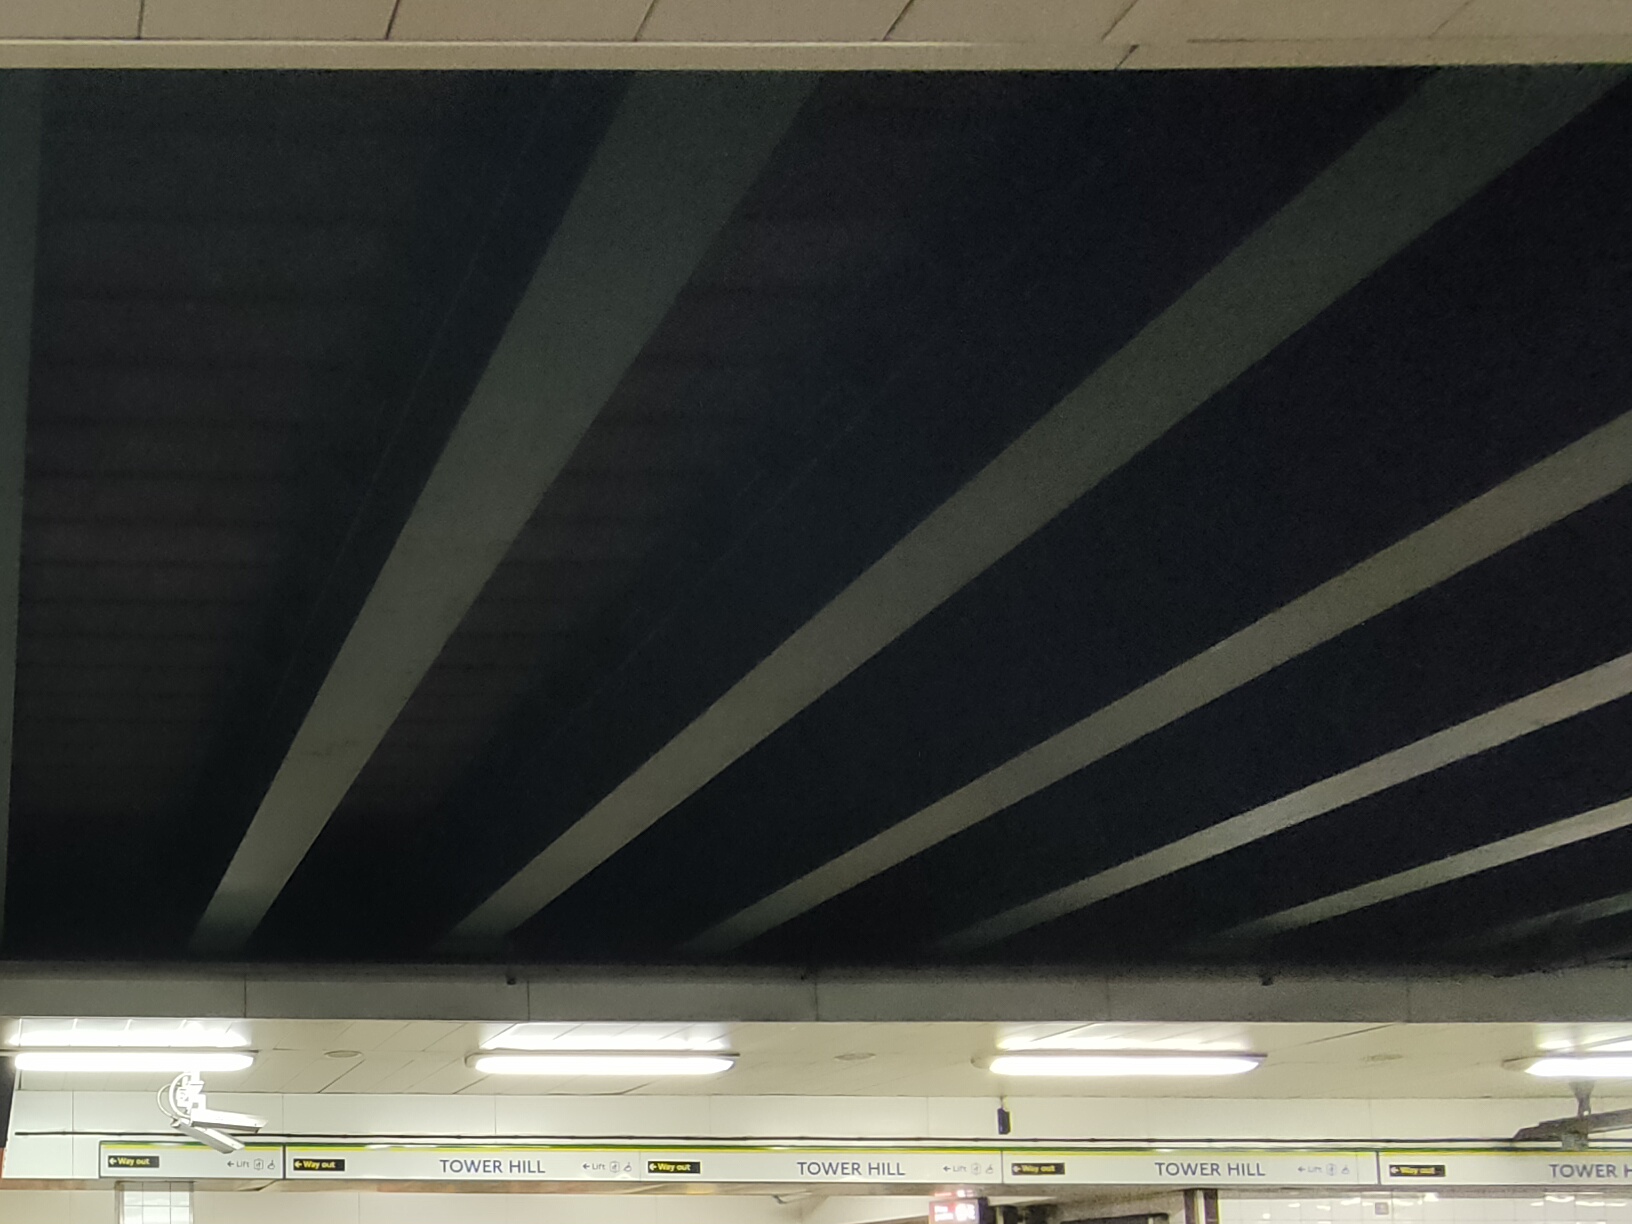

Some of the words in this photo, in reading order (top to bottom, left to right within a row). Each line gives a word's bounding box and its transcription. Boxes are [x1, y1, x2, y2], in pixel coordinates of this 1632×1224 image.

[118, 1157, 135, 1166] Way
[136, 1157, 150, 1165] out
[236, 1160, 250, 1168] Lift
[302, 1160, 320, 1170] Way
[321, 1160, 336, 1168] out
[440, 1159, 503, 1173] TOWER
[509, 1160, 545, 1173] HILL
[592, 1162, 606, 1170] Lift
[657, 1162, 675, 1172] Way
[676, 1162, 691, 1171] out
[797, 1161, 862, 1175] TOWER
[868, 1162, 905, 1176] HILL
[952, 1164, 967, 1172] Lift
[1021, 1164, 1040, 1174] Way
[1040, 1164, 1056, 1173] out
[1154, 1162, 1221, 1176] TOWER
[1227, 1162, 1265, 1176] HILL
[1549, 1164, 1617, 1178] TOWER
